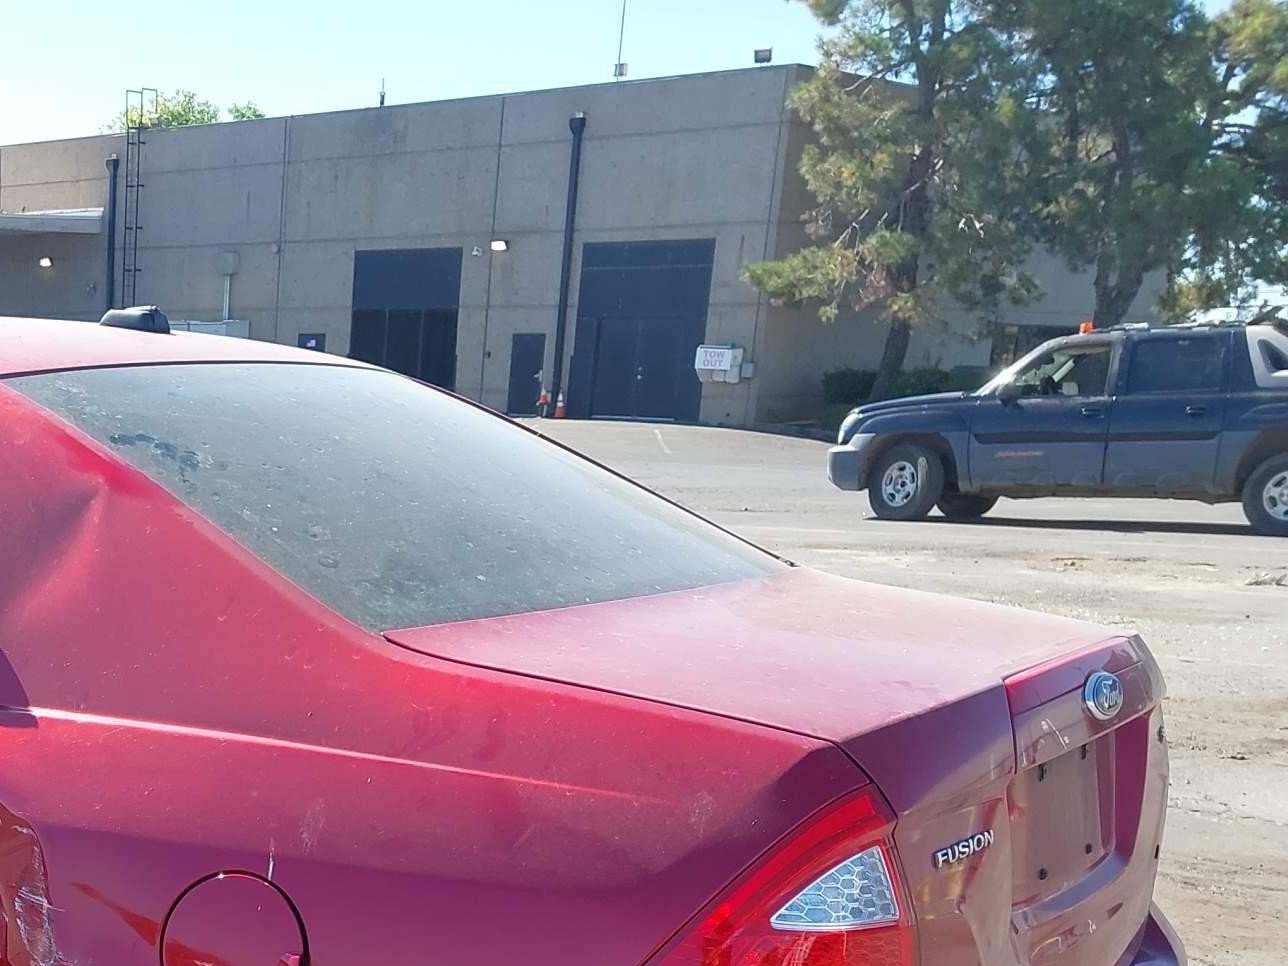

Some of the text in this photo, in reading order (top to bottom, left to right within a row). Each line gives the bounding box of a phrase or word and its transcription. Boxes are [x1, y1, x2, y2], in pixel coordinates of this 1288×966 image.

[703, 349, 726, 359] TOW
[703, 359, 724, 368] OUT
[1101, 679, 1120, 710] Ford
[934, 828, 995, 869] FUSION
